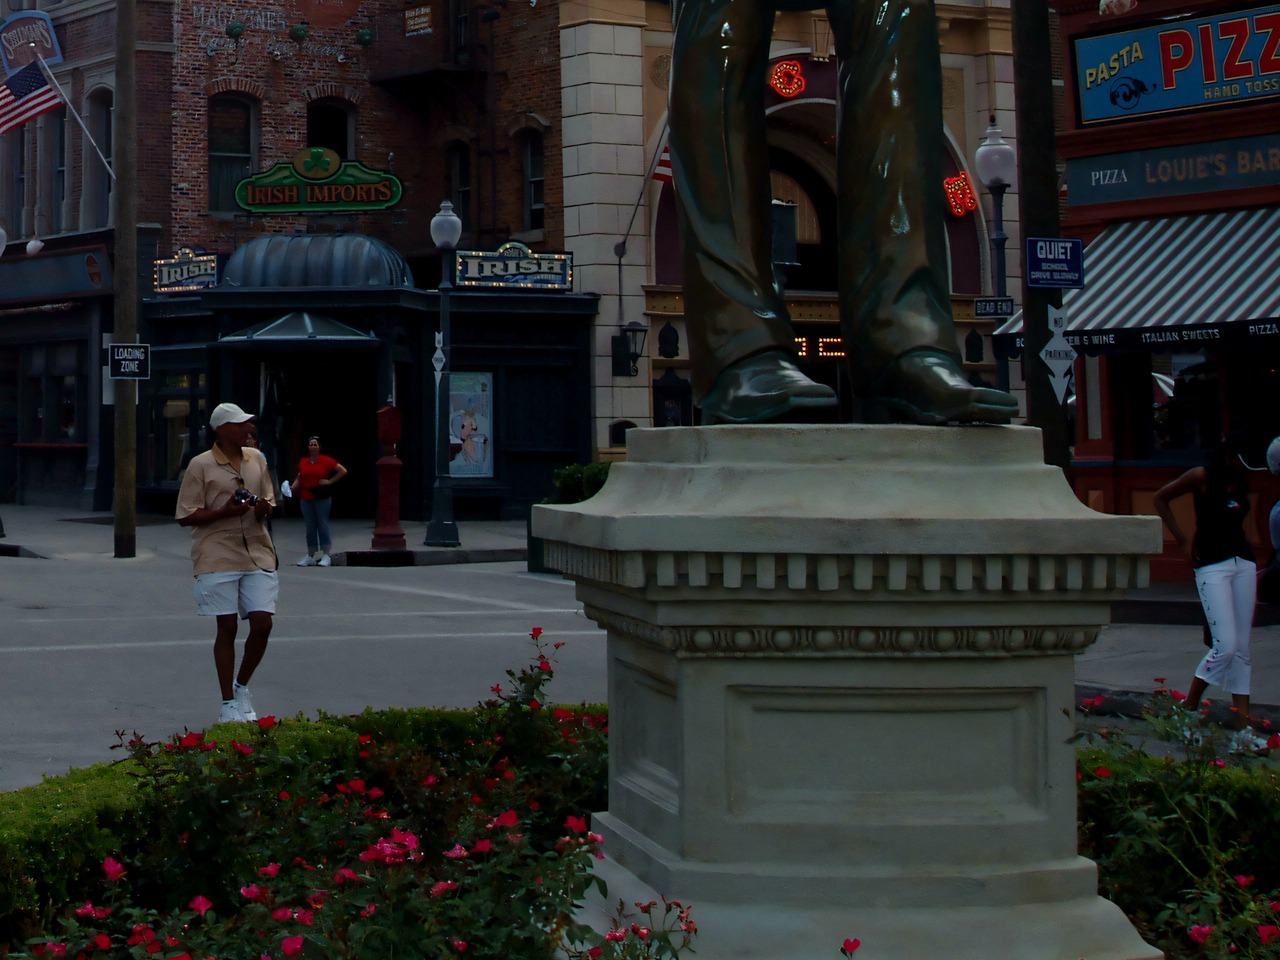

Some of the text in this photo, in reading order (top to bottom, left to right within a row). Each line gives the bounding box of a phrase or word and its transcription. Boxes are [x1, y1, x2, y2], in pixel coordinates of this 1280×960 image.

[1158, 12, 1280, 90] PIZZ
[1086, 41, 1145, 89] PASTA
[1204, 78, 1279, 99] HAND TOSS
[1091, 168, 1128, 186] PIZZA
[1145, 154, 1227, 184] LOUIE'S
[246, 180, 392, 204] IRISH IMPORTS
[1037, 241, 1073, 259] QUIET
[160, 260, 215, 285] IRISH
[464, 258, 564, 279] IRISH
[997, 301, 1012, 313] END
[1053, 317, 1064, 328] NO
[1249, 323, 1280, 335] PIZZA
[1141, 328, 1220, 343] ITALIAN SWEETS
[114, 347, 146, 360] LOADING
[120, 361, 140, 372] ZONE
